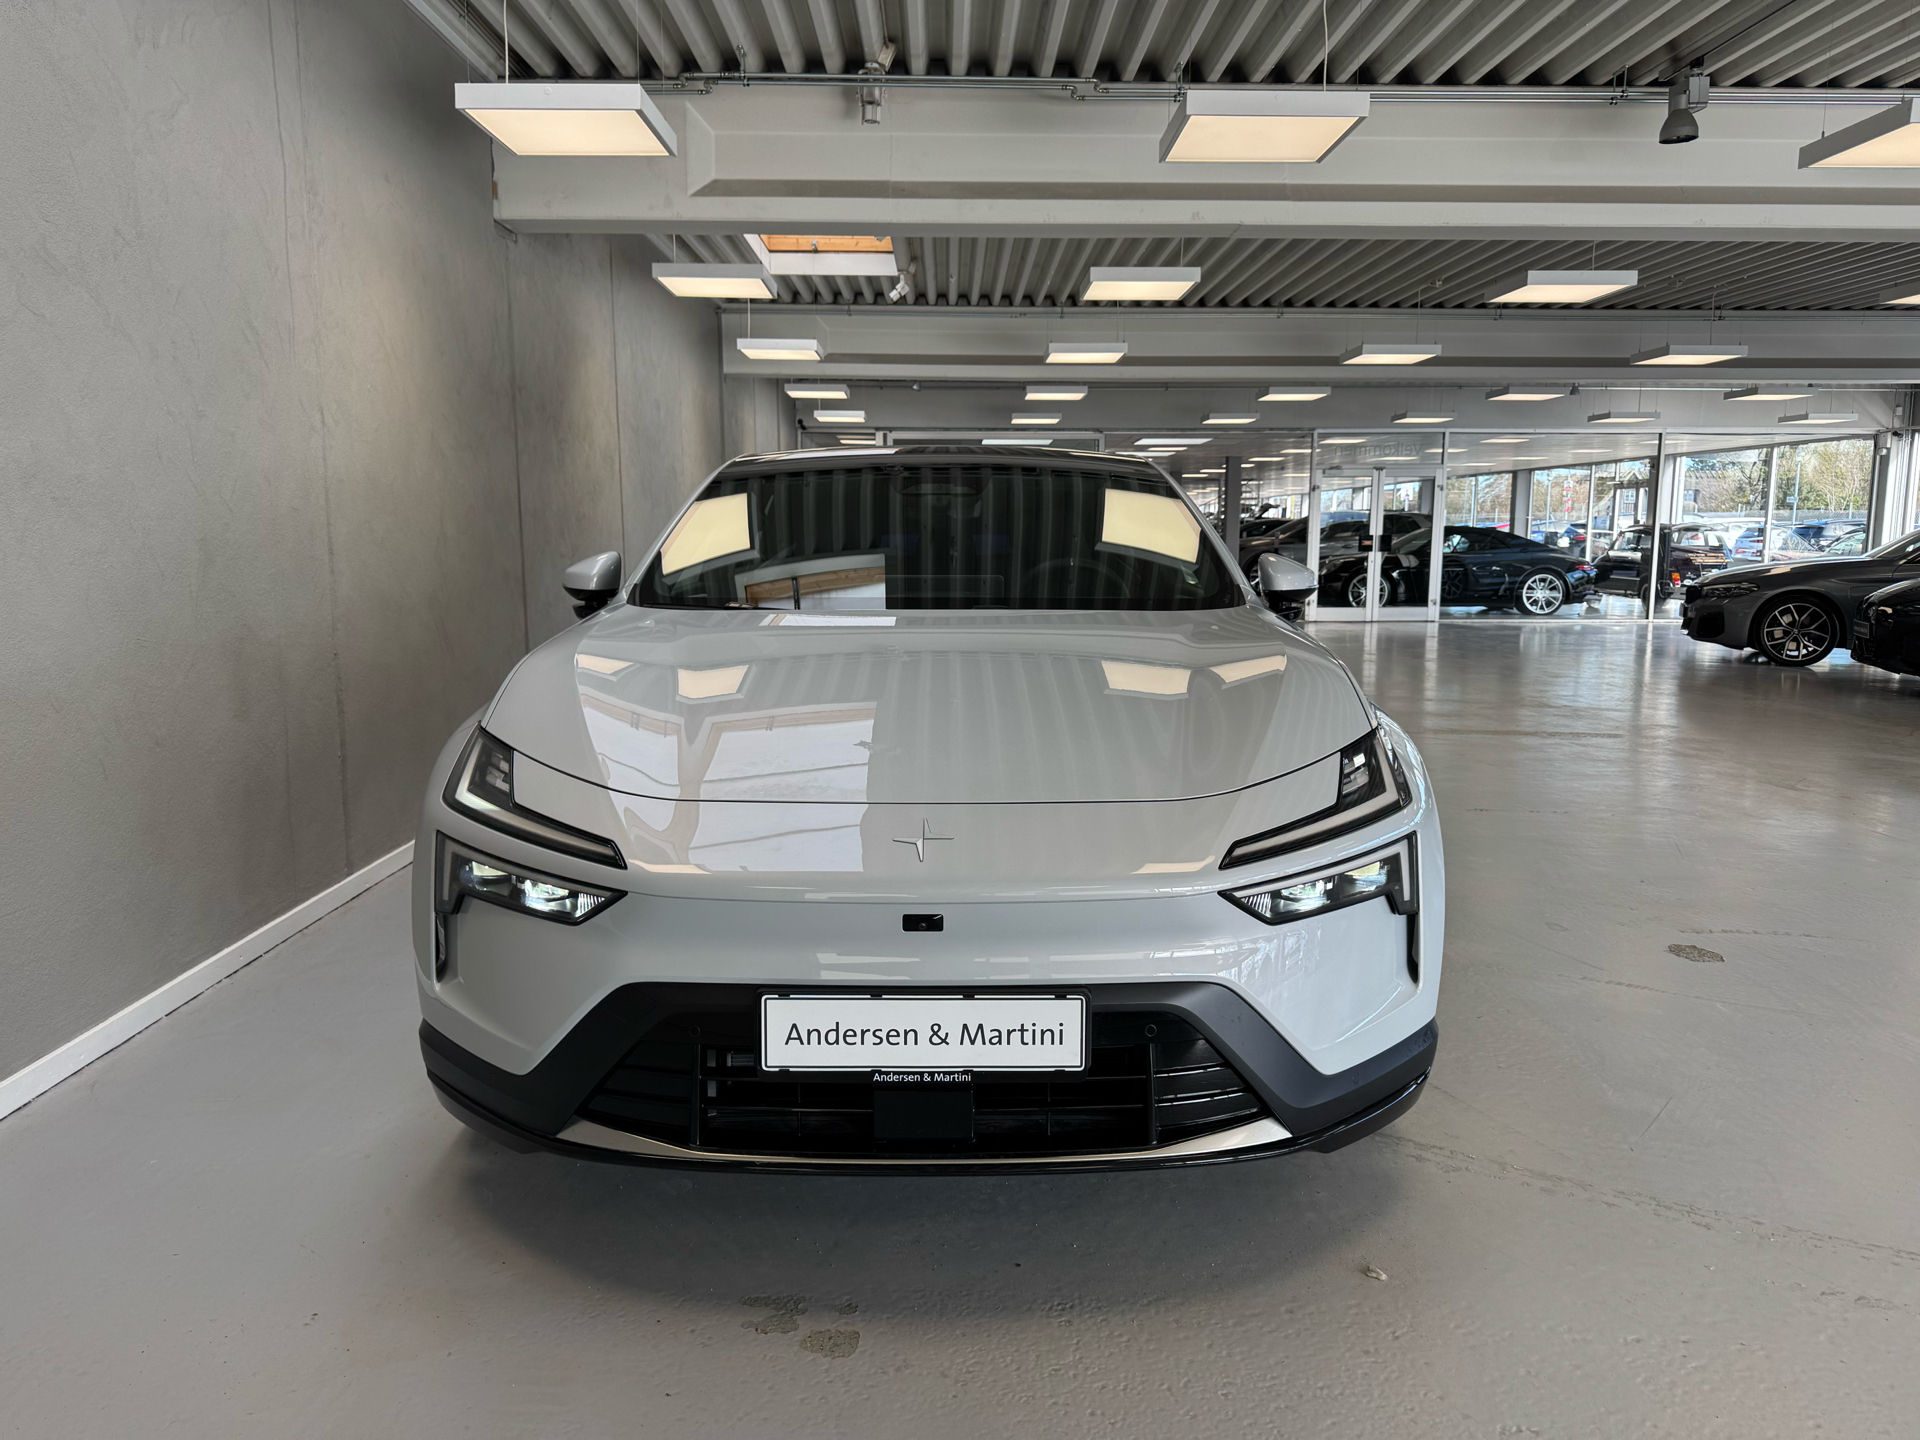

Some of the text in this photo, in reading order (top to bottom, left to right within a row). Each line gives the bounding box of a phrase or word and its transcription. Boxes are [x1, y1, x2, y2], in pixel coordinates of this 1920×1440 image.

[784, 1021, 1064, 1046] Andersen & Martini
[873, 1072, 972, 1082] Andersen & Martini
